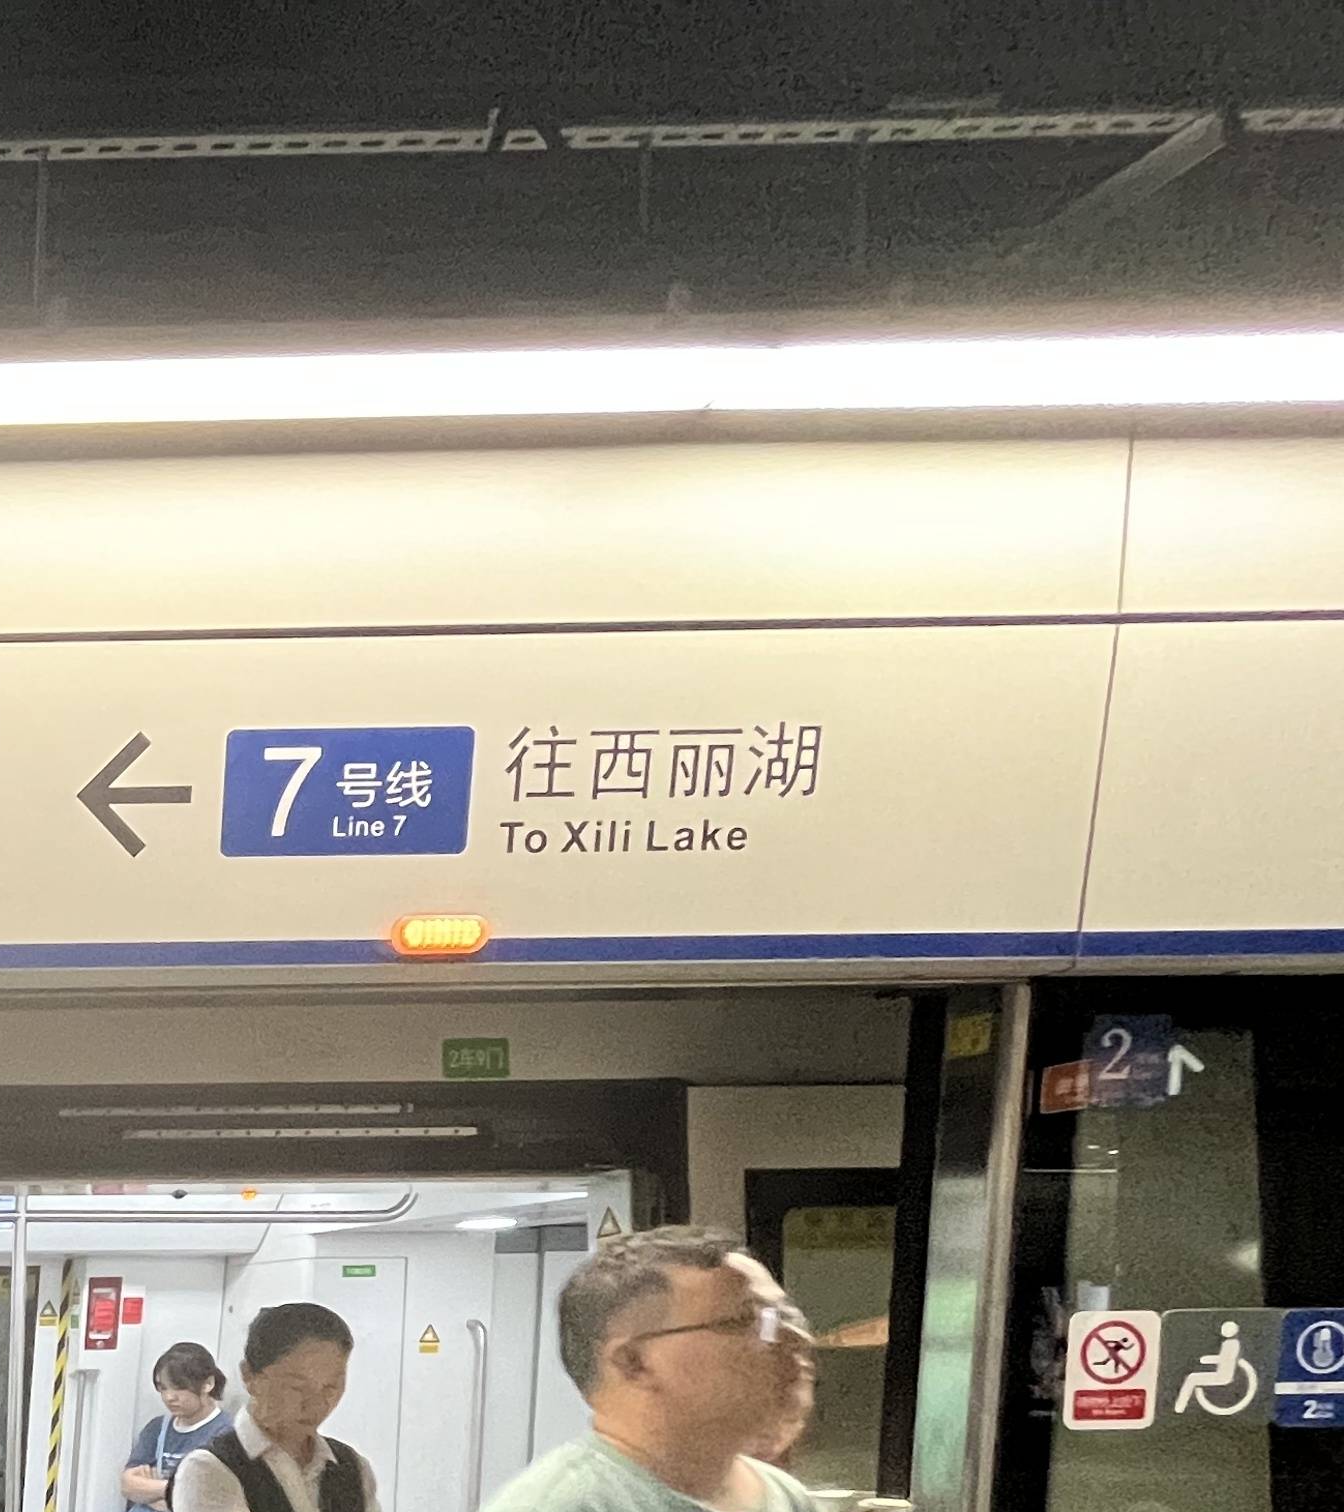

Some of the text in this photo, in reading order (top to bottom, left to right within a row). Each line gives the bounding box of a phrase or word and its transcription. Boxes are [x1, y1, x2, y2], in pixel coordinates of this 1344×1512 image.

[337, 761, 433, 809] 号线
[505, 722, 824, 801] 往西丽湖
[263, 747, 322, 837] 7
[333, 815, 406, 837] Line 7
[501, 820, 748, 853] To Xili Lake
[1099, 1028, 1132, 1080] 2
[1302, 1399, 1317, 1418] 2
